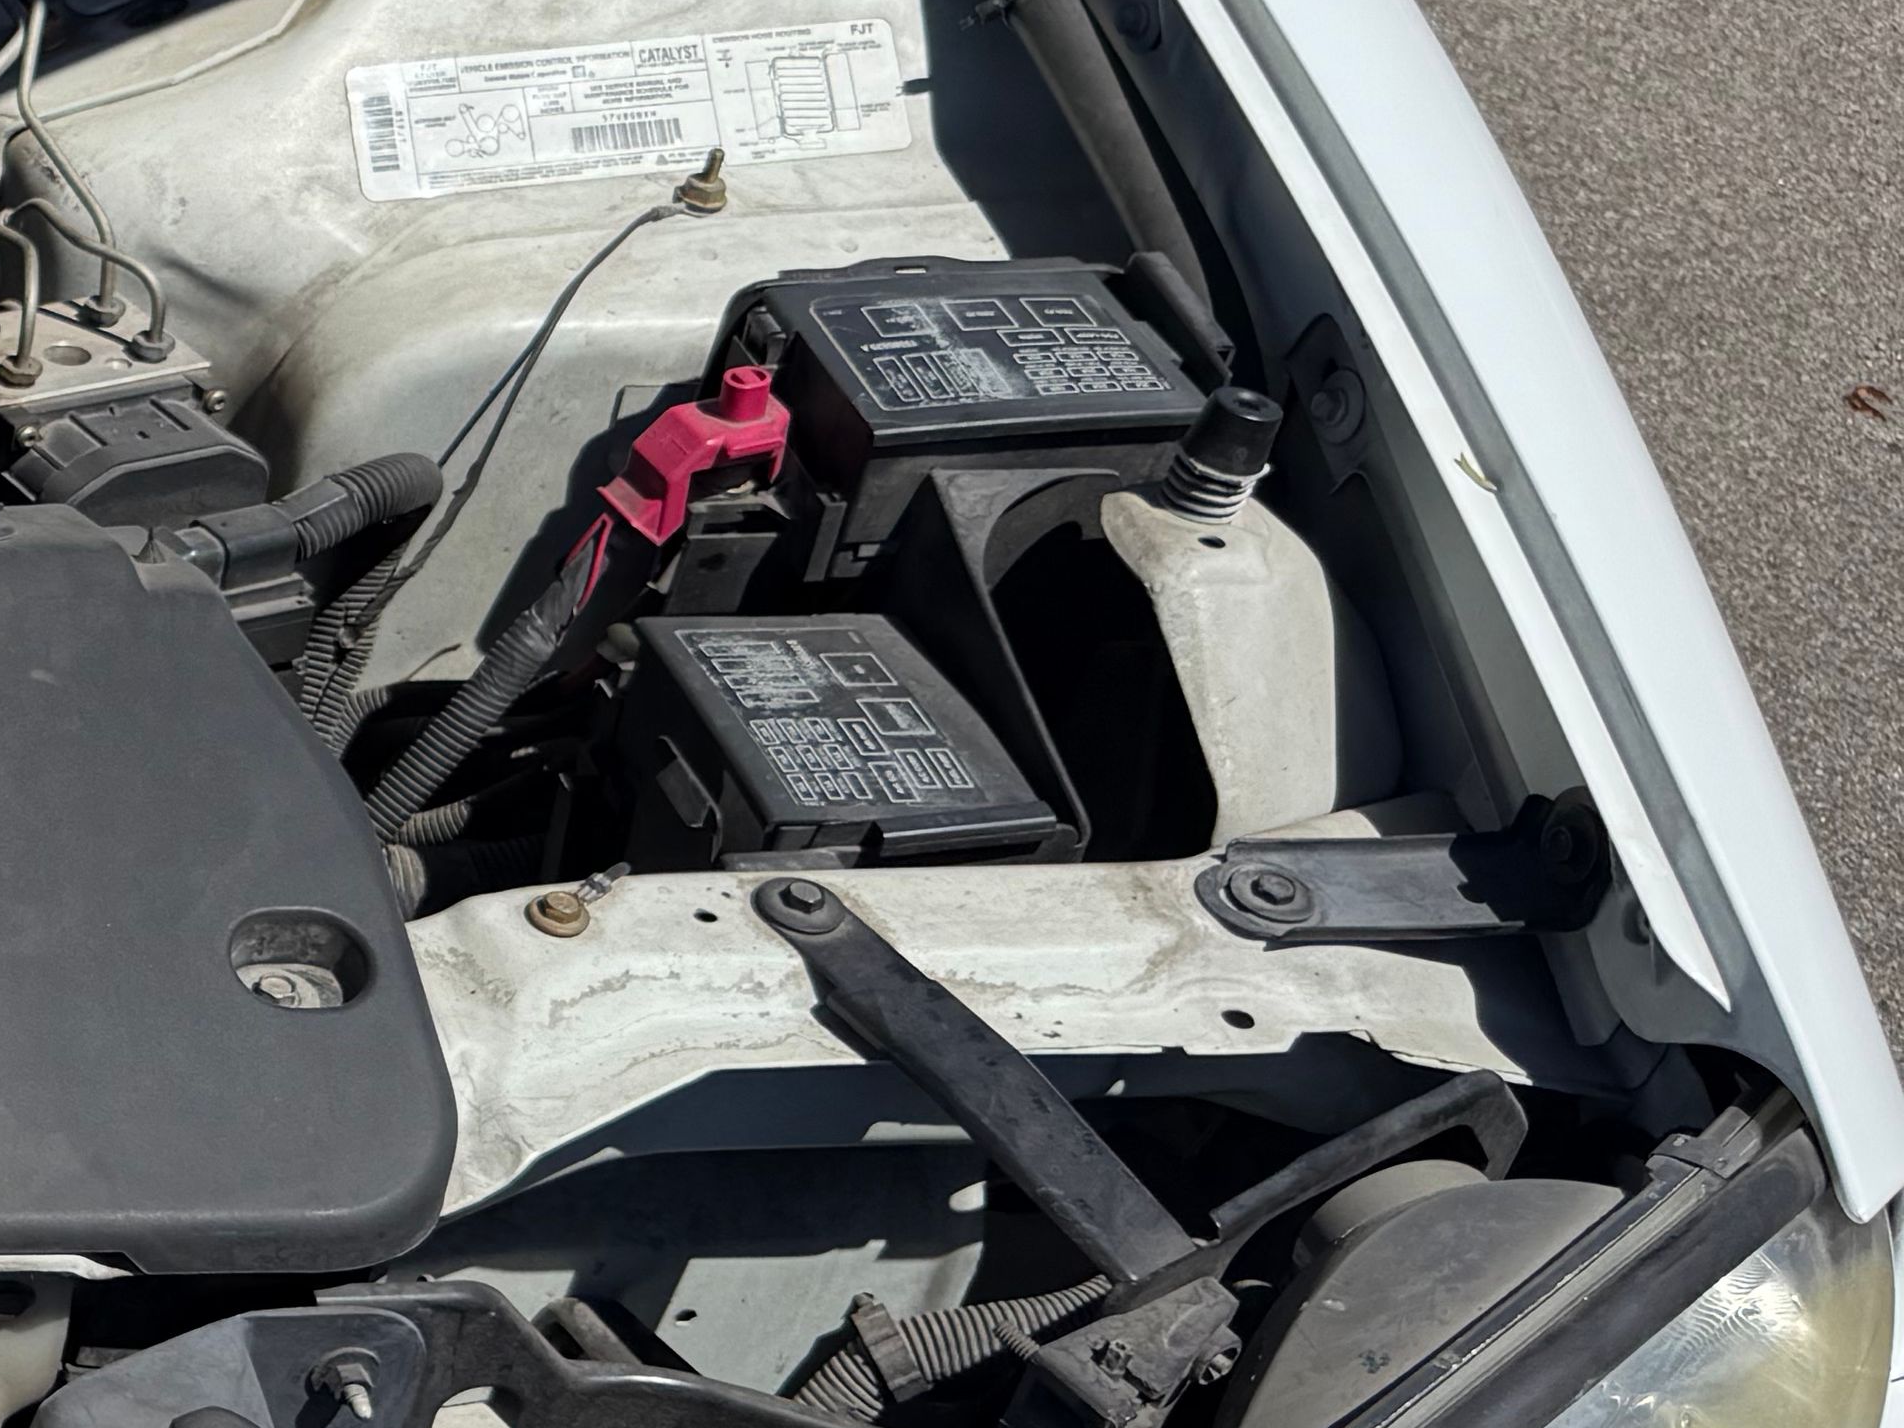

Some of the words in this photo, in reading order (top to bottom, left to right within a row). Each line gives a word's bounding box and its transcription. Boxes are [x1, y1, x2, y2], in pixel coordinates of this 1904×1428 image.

[850, 23, 874, 35] FJT
[638, 45, 698, 63] CATALYST
[535, 57, 573, 67] CONTROL
